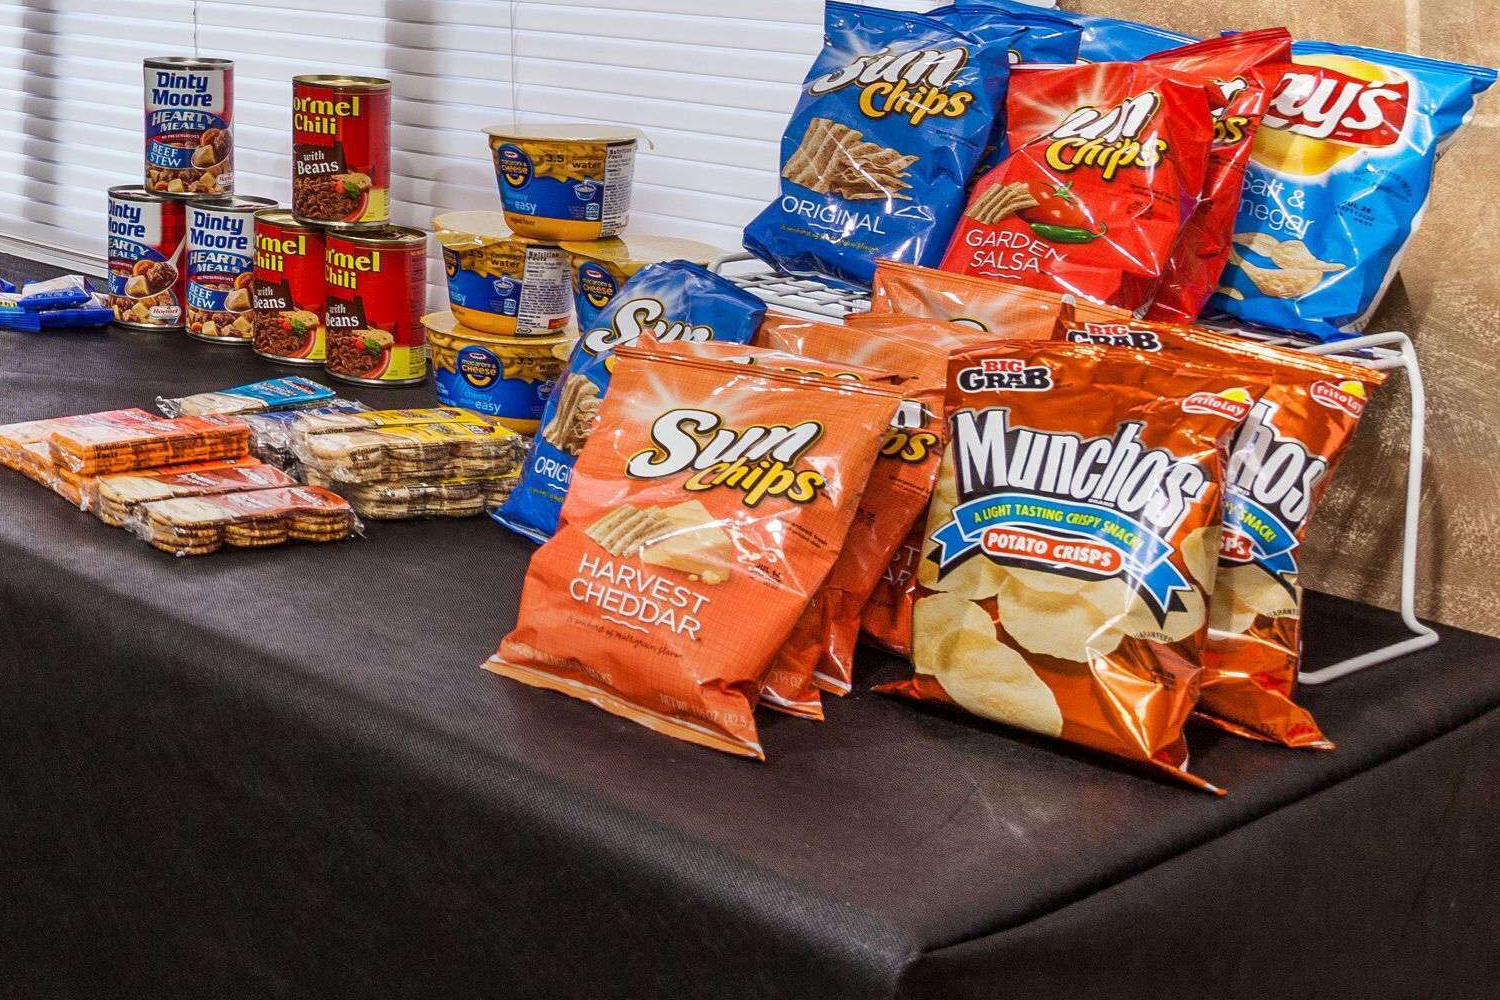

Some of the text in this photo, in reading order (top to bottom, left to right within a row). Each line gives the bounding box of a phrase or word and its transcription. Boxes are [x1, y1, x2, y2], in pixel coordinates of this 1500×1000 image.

[809, 47, 966, 96] Sun
[156, 72, 209, 93] Dinty
[152, 89, 213, 107] Moore
[859, 80, 975, 127] Chips
[152, 111, 216, 126] HEARTY
[161, 121, 206, 133] MEALS
[294, 113, 337, 135] Chili
[152, 142, 179, 156] BEEF
[303, 150, 325, 162] with
[1045, 136, 1168, 180] Chips
[150, 153, 182, 168] STEW
[297, 160, 339, 175] Beans
[571, 161, 601, 169] water
[1243, 169, 1305, 210] Salt &
[514, 201, 537, 215] easy
[781, 195, 886, 235] ORIGINAL
[108, 217, 146, 238] oore
[193, 211, 244, 235] Dinty
[1238, 198, 1315, 241] negar
[190, 228, 248, 250] Moore
[965, 228, 1068, 262] GARDEN
[189, 251, 252, 268] HEARTY
[196, 262, 240, 273] MEALS
[971, 251, 1042, 273] SALSA
[189, 283, 213, 299] BEEF
[257, 286, 273, 296] with
[188, 296, 216, 310] STEW
[329, 303, 346, 314] with
[1086, 324, 1128, 336] BIG
[982, 360, 1023, 373] BIG
[959, 366, 1051, 392] GRAB
[474, 400, 502, 416] easy
[95, 441, 131, 450] Nutrition
[625, 408, 825, 479] Sun
[951, 409, 1206, 530] Munchos
[684, 456, 825, 509] Chips
[974, 512, 982, 524] A
[983, 504, 1012, 521] LIGHT
[1015, 503, 1064, 522] TASTING
[1066, 512, 1101, 529] CRISPY
[1239, 509, 1279, 544] SNACK!
[988, 532, 1113, 568] POTATO CRISPS
[578, 552, 711, 617] HARVEST
[569, 579, 702, 641] CHEDDAR
